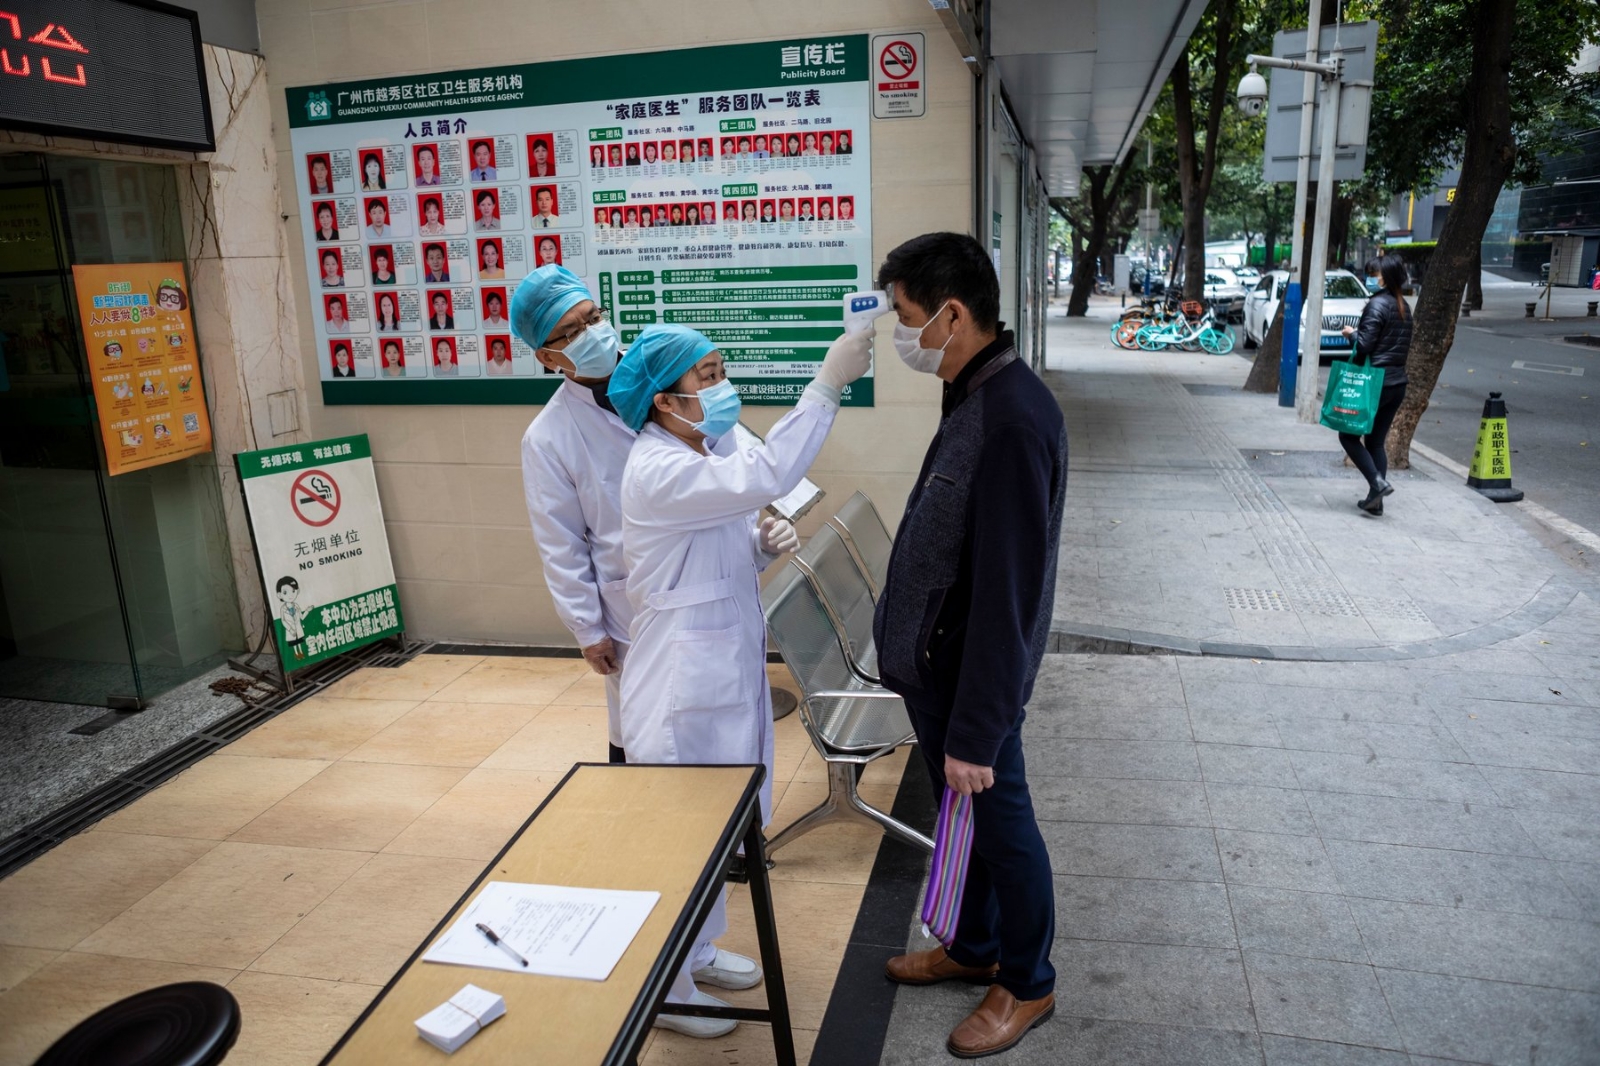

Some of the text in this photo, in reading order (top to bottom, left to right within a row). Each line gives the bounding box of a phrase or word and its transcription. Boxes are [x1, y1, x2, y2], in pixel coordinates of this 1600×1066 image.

[781, 43, 845, 67] 宣传栏
[781, 67, 845, 80] Publicity Board
[337, 74, 523, 106] 广州市越秀区社区卫生服务机构
[338, 92, 524, 116] GUANGZHOU YUEXIU COMMUNITY HEALTH SERVICE AGENCY
[404, 118, 467, 138] 人员简介
[589, 128, 622, 140] 第一团队
[720, 119, 756, 131] 第二团队
[593, 191, 625, 202] 第三团队
[723, 184, 757, 197] 第四团队
[93, 294, 150, 309] 新型冠状病毒
[89, 306, 157, 326] 人人要做8件事
[260, 443, 352, 469] 无烟环境 有益健康
[1491, 422, 1506, 475] 市政职工医院
[294, 529, 361, 558] 无烟单位
[299, 548, 363, 571] NO SMOKING
[320, 589, 395, 628] 本中心为无烟单位
[305, 608, 399, 657] 室内任何区域禁止吸烟
